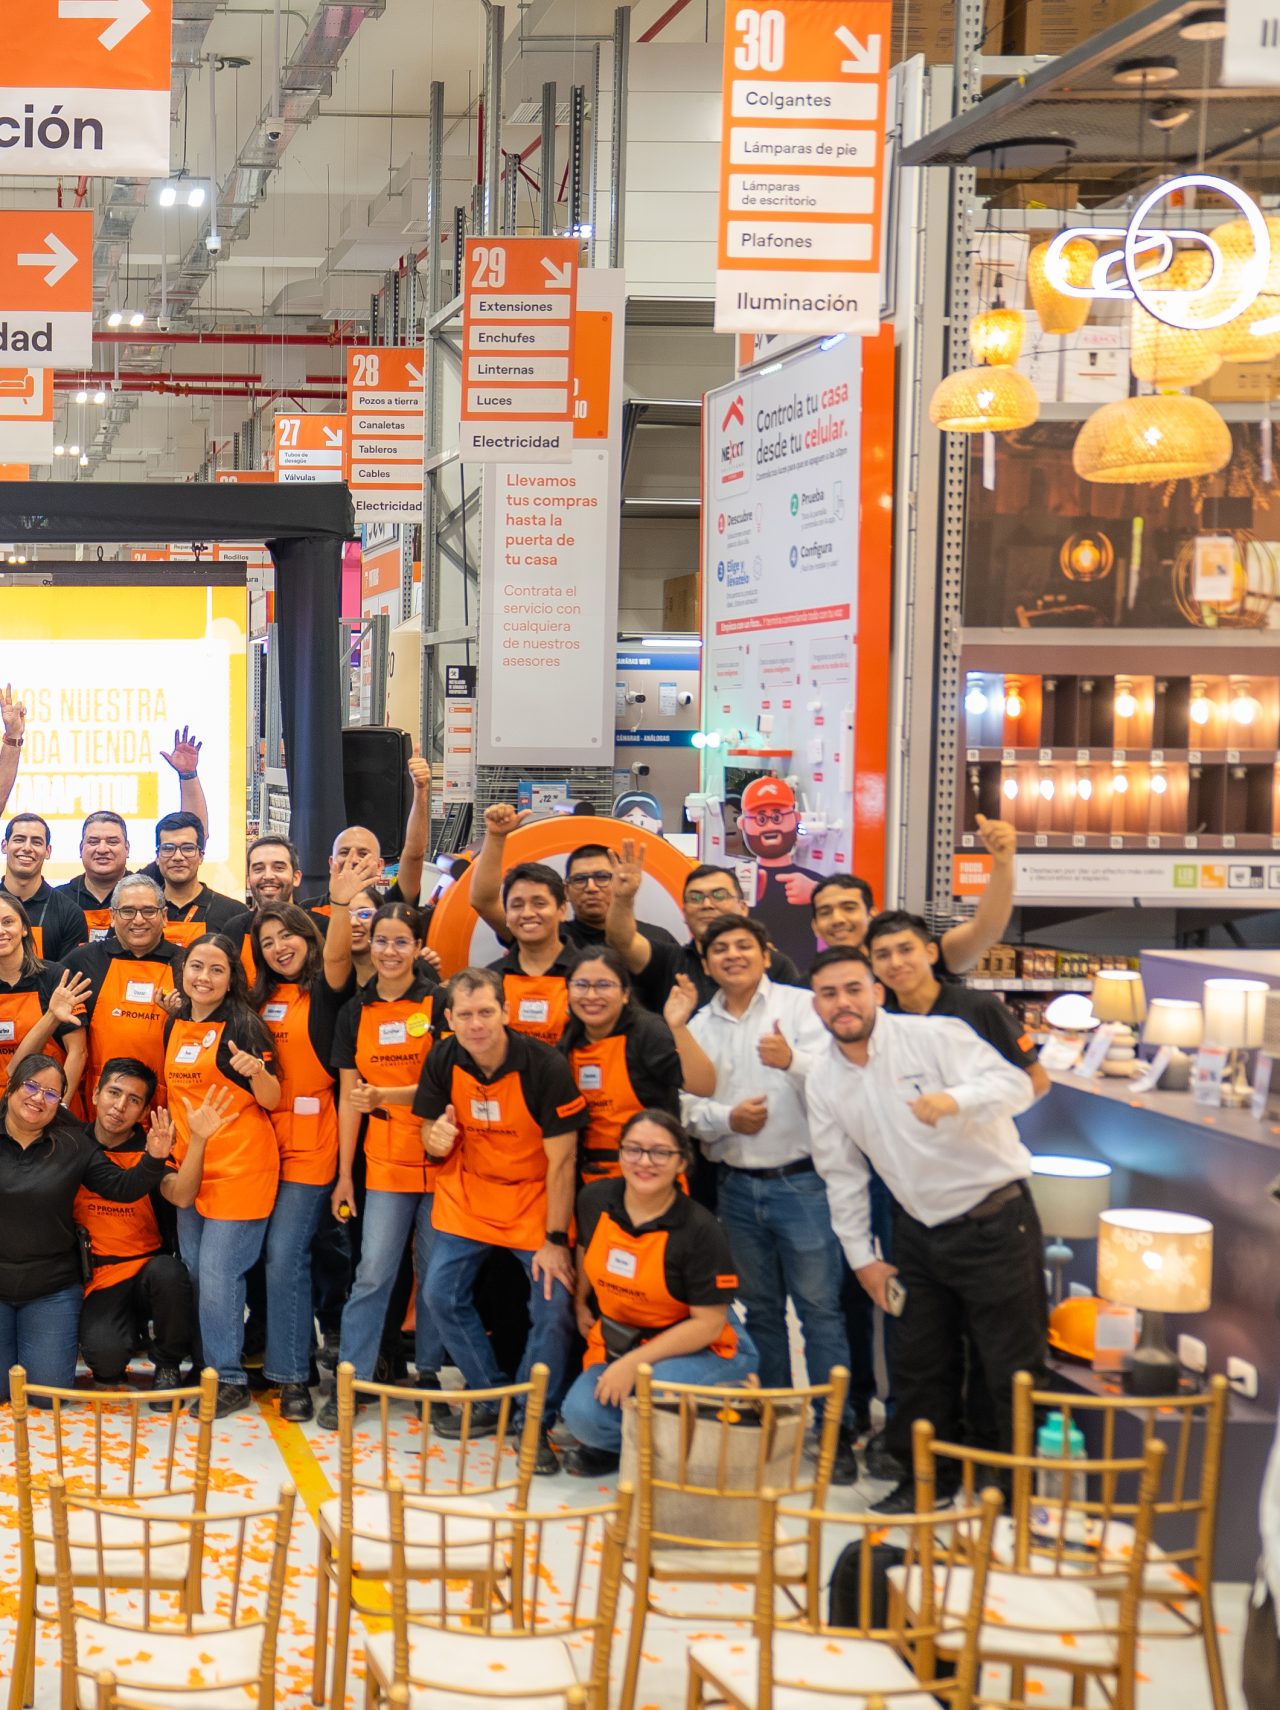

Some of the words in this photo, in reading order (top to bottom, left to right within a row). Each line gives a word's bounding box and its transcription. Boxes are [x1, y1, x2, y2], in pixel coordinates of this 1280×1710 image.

[734, 9, 785, 72] 30
[746, 91, 832, 110] Colgantes
[744, 141, 812, 157] Lámparas
[816, 142, 832, 156] de
[836, 143, 857, 159] pie
[742, 180, 800, 193] Lámparas
[742, 195, 756, 206] de
[759, 195, 817, 207] escritorio
[741, 233, 812, 249] Plafones
[471, 247, 506, 288] 29
[479, 301, 553, 312] Extensiones
[737, 292, 858, 312] Iluminación
[478, 332, 535, 343] Enchufes
[352, 355, 379, 387] 28
[477, 365, 534, 375] Linternas
[359, 396, 385, 406] Pozos
[394, 397, 419, 406] tierra
[477, 396, 512, 406] Luces
[756, 393, 803, 432] Controla
[806, 394, 818, 415] tu
[821, 383, 848, 409] casa
[359, 421, 405, 430] Canaletas
[279, 419, 300, 446] 27
[756, 432, 787, 464] desde
[790, 434, 802, 454] tu
[805, 414, 848, 449] celular.
[473, 436, 559, 448] Electricidad
[358, 446, 397, 454] Tableros
[285, 473, 316, 482] Válvulas
[358, 470, 390, 478] Cables
[506, 474, 577, 487] Llevamos
[506, 495, 529, 506] tus
[533, 496, 598, 509] compras
[801, 489, 824, 505] Prueba
[356, 501, 422, 512] Electricidad
[506, 513, 547, 526] hasta
[550, 513, 562, 526] la
[727, 509, 753, 526] Descubre
[505, 535, 553, 548] puerta
[557, 534, 575, 546] de
[800, 541, 833, 559] Configura
[505, 554, 520, 565] tu
[524, 556, 557, 566] casa
[504, 585, 562, 597] Contrata
[566, 586, 577, 597] el
[504, 603, 553, 614] servicio
[556, 605, 581, 615] con
[503, 620, 570, 633] cualquiera
[503, 638, 519, 649] de
[523, 639, 580, 650] nuestros
[502, 656, 560, 667] asesores
[61, 688, 167, 723] NUESTRA
[70, 729, 152, 764] TIENDA
[121, 1010, 160, 1021] PROMART
[380, 1053, 420, 1062] PROMART
[97, 1206, 135, 1214] PROMART
